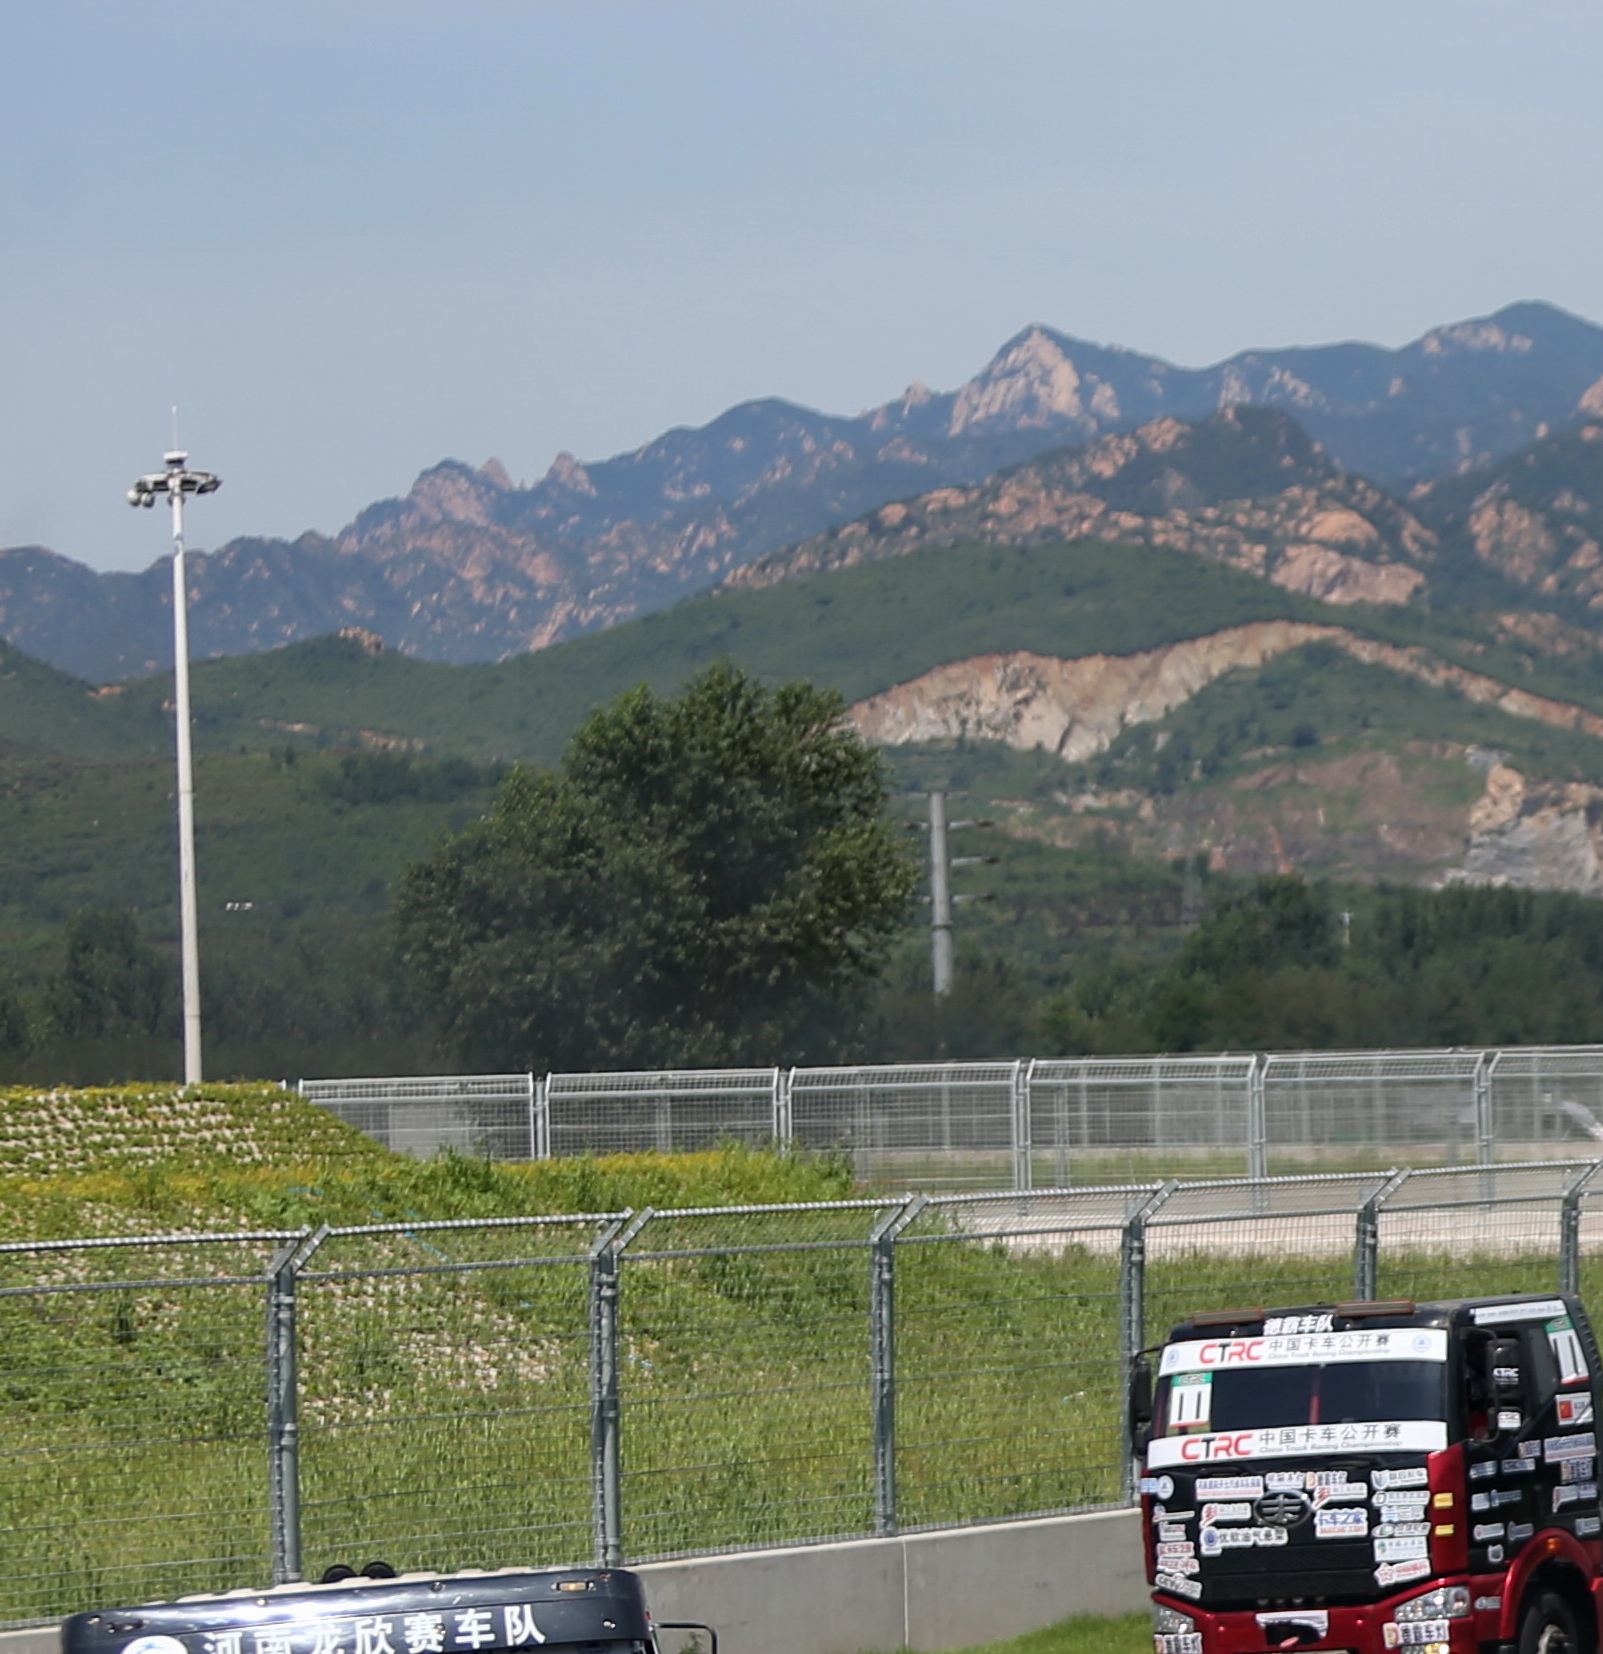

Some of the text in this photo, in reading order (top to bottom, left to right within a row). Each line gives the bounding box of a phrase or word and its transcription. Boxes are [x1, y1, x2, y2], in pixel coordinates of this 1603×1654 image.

[1199, 1341, 1265, 1364] CTRC
[1268, 1333, 1391, 1352] 中国卡车公开赛
[1177, 1389, 1203, 1422] 11
[1259, 1422, 1402, 1446] 中国卡车公开赛
[1181, 1434, 1255, 1461] CTRC
